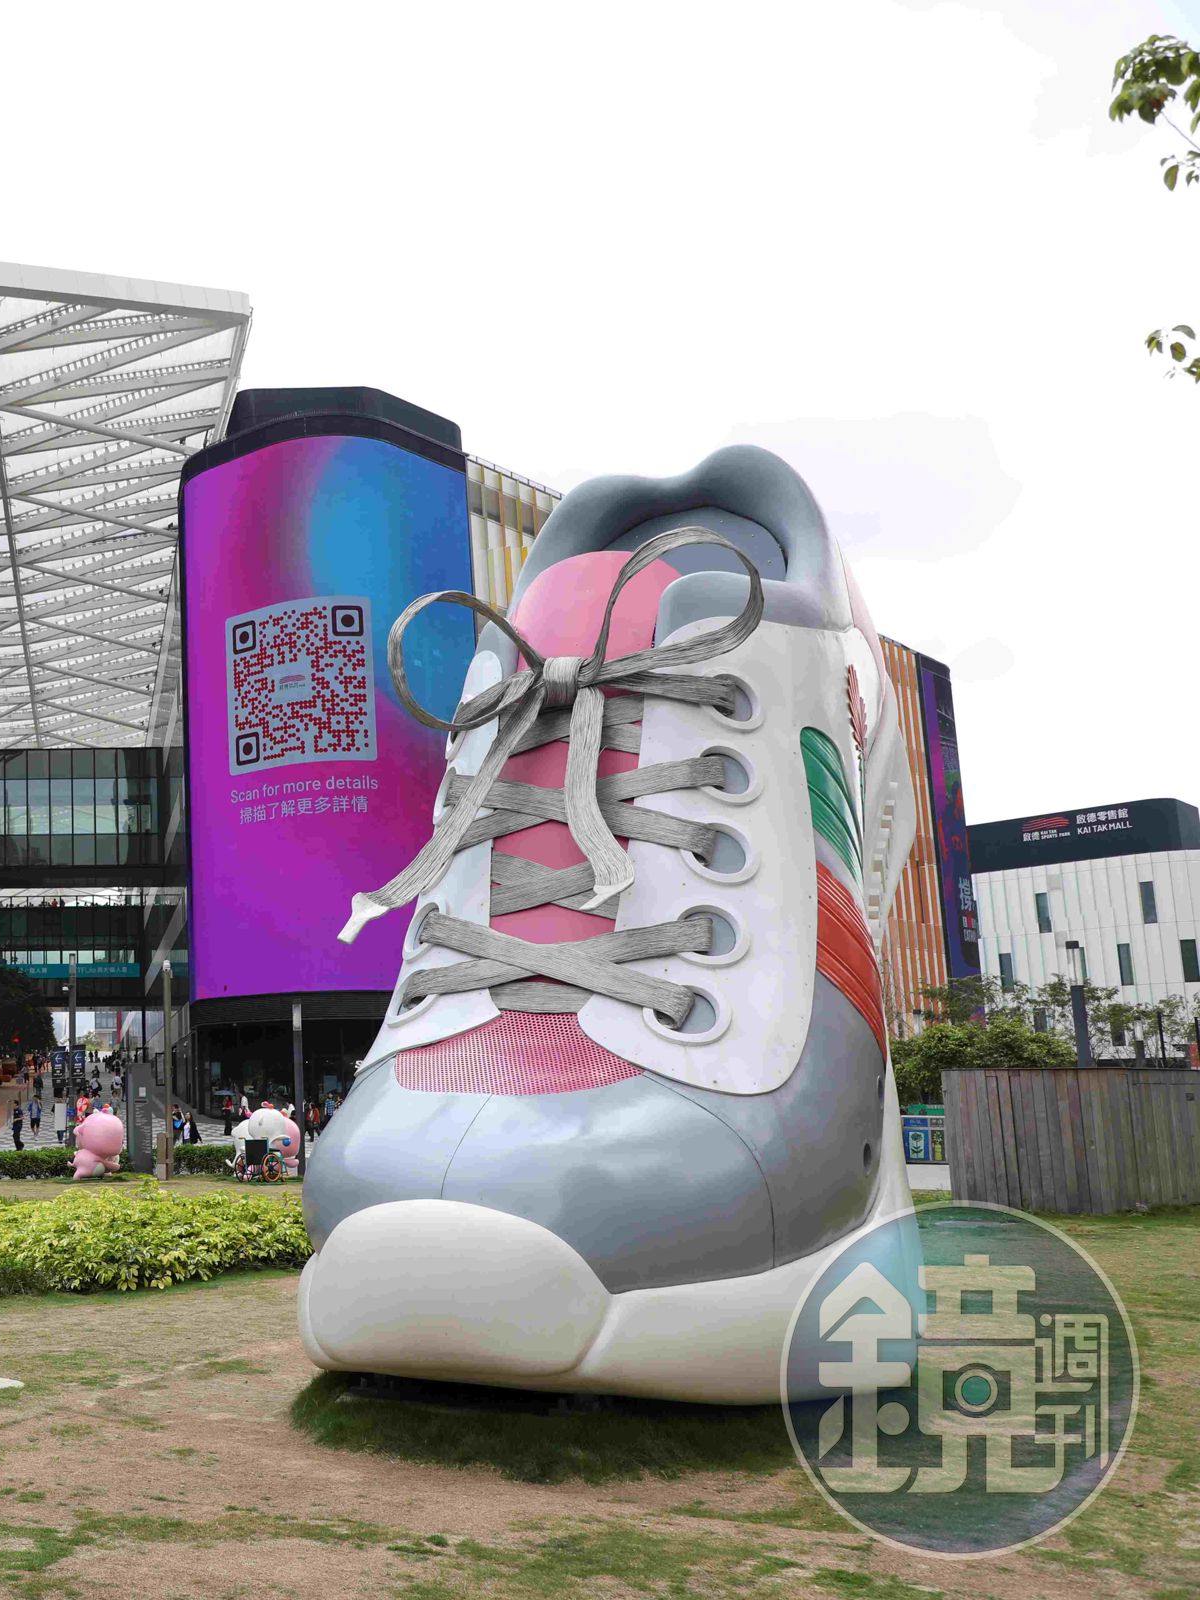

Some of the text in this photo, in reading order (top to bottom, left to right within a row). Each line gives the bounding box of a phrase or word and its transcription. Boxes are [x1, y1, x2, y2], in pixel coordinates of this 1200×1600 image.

[230, 775, 378, 803] Scan for more details
[239, 795, 368, 825] 掃描了解更多詳情
[1076, 808, 1129, 825] 啟德零售館
[1077, 821, 1133, 835] KAI TAK MALL
